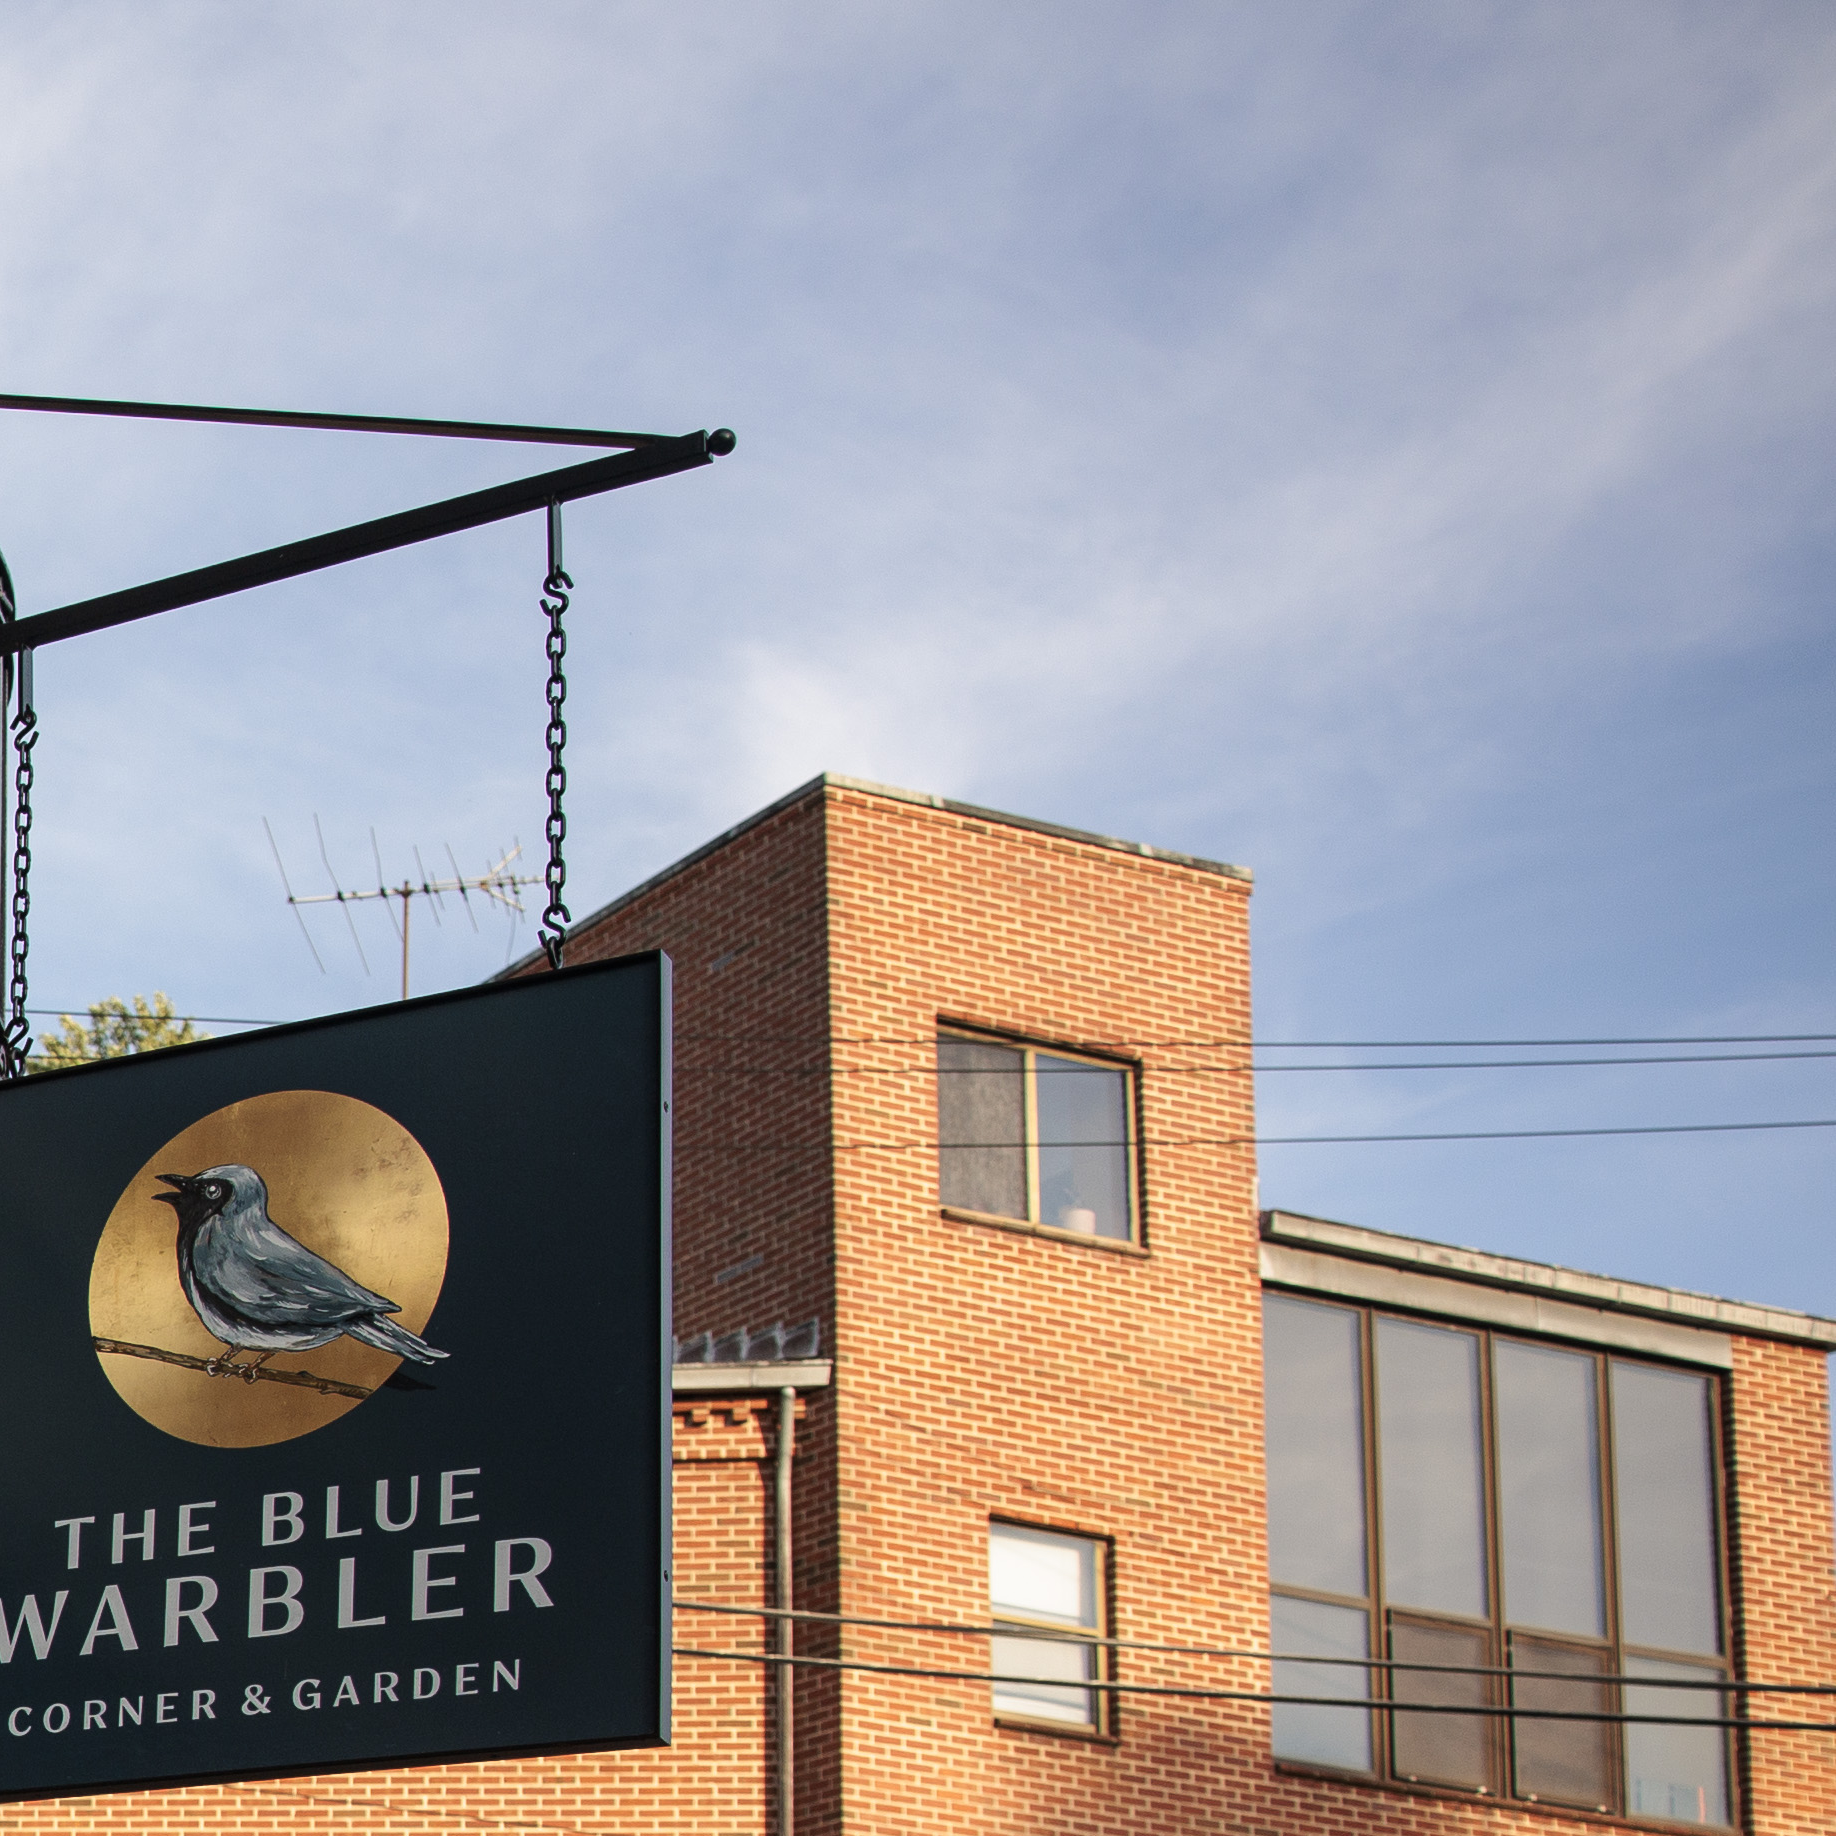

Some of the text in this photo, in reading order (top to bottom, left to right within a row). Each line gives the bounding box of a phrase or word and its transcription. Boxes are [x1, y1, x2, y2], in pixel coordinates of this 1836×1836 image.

[54, 1467, 482, 1570] THE BLUE
[7, 1657, 523, 1738] CORNER & GARDEN
